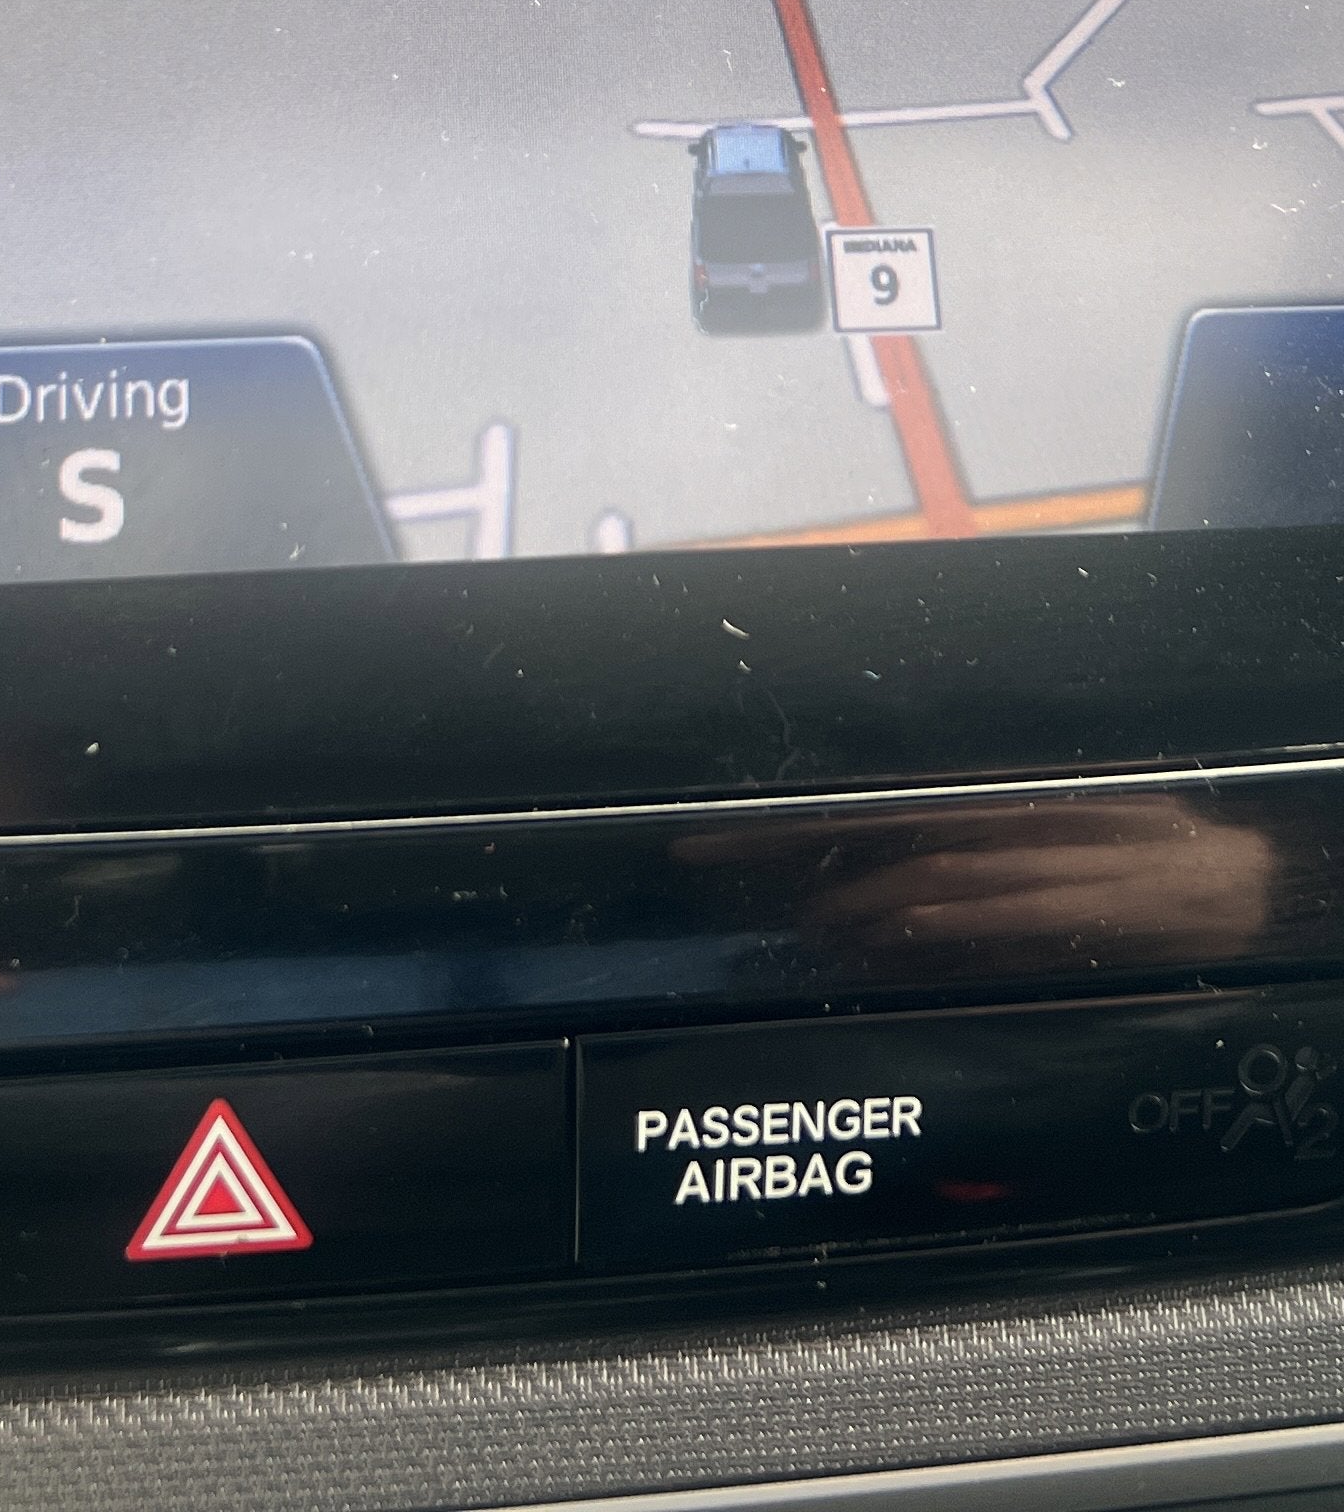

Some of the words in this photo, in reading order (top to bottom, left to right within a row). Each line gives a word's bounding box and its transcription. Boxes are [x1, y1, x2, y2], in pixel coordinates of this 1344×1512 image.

[871, 264, 899, 306] 9
[59, 448, 125, 543] S
[636, 1096, 923, 1152] PASSENGER
[1128, 1086, 1236, 1133] OFF
[674, 1150, 874, 1204] AIRBAG
